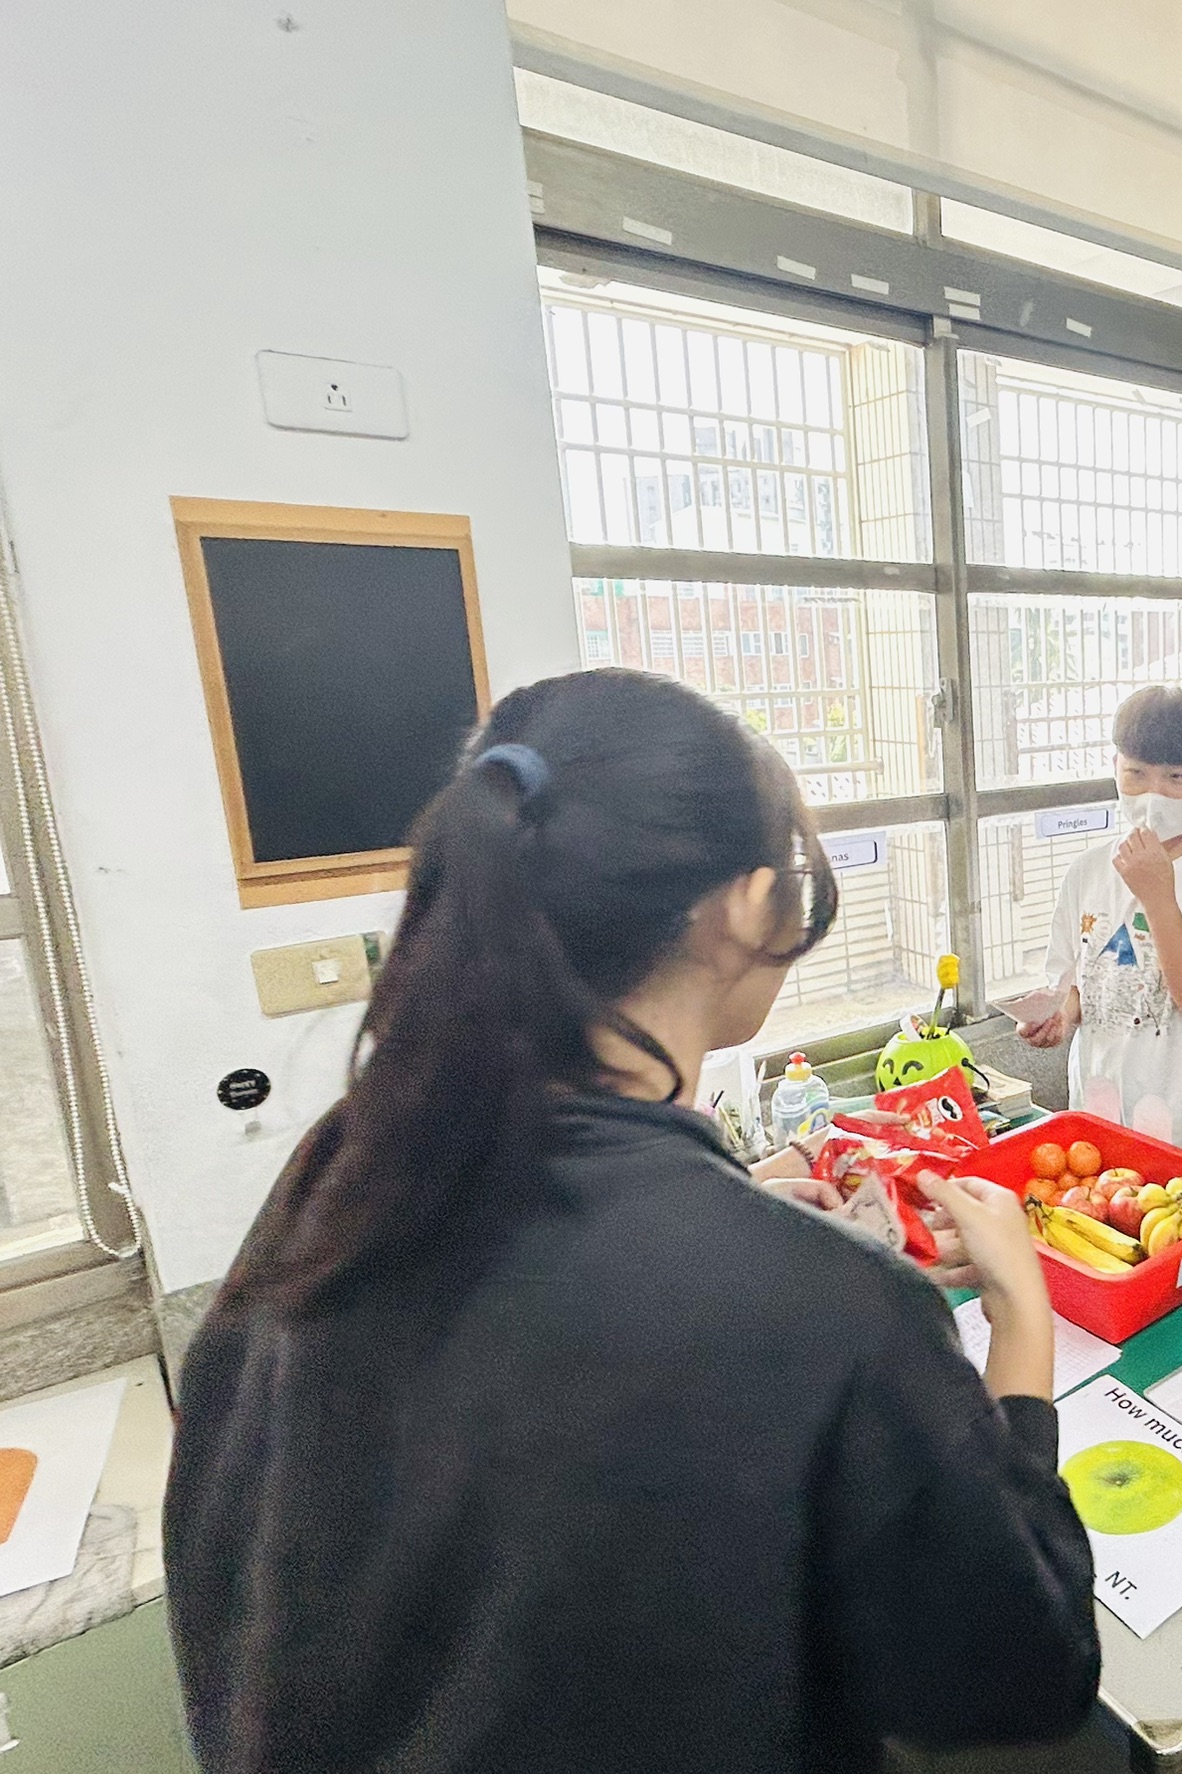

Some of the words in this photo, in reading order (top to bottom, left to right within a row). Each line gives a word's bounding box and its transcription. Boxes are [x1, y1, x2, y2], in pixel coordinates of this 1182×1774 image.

[1057, 818, 1088, 829] Pringles
[829, 853, 849, 862] nas
[1104, 1387, 1147, 1419] How
[1104, 1571, 1137, 1600] NT.
